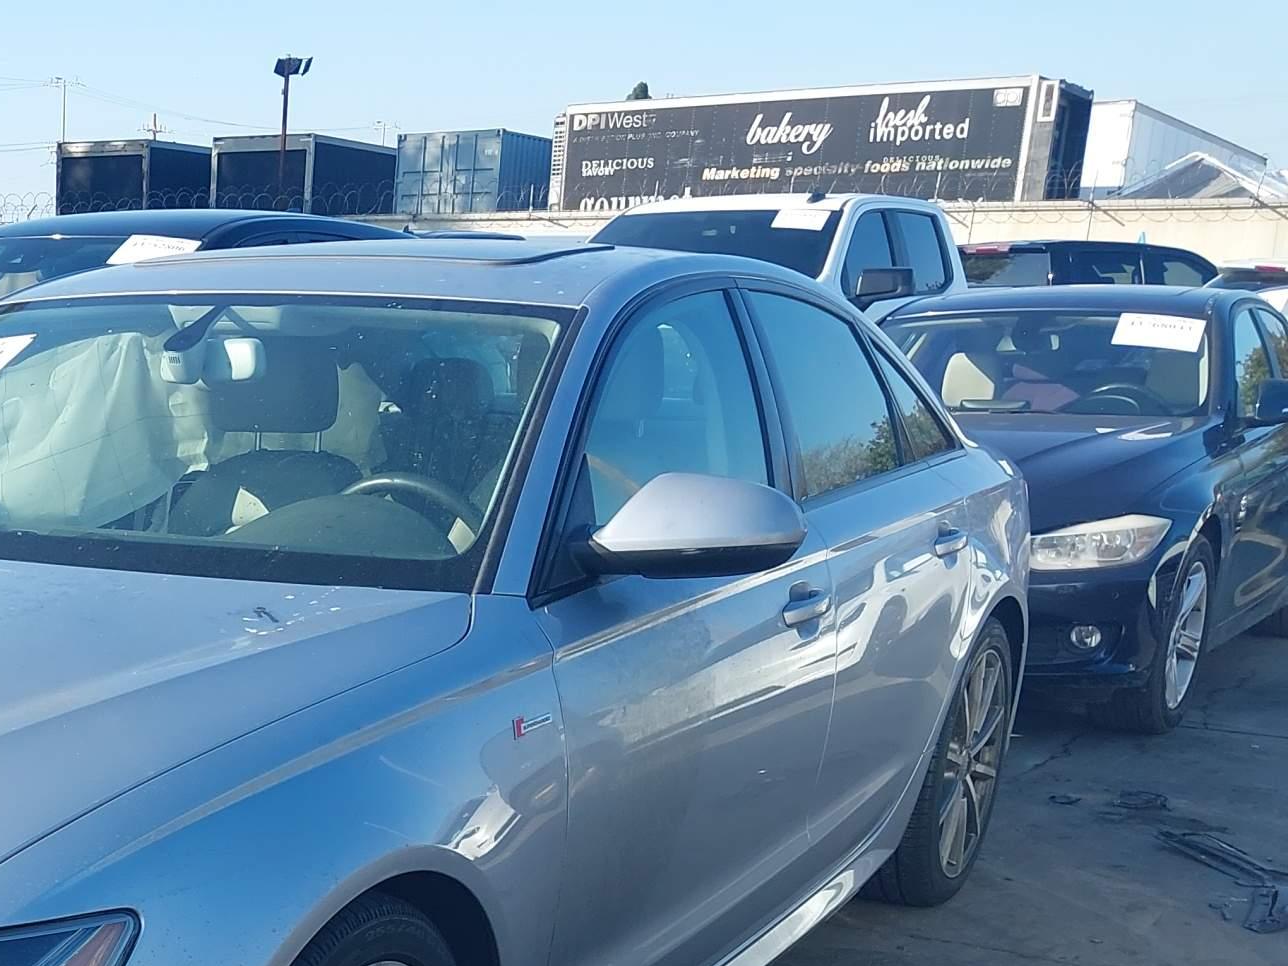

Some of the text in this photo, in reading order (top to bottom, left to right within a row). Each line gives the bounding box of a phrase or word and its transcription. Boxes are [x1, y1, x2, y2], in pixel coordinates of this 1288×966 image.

[746, 112, 833, 155] bakery
[869, 117, 970, 146] imported
[582, 157, 655, 170] DELICIOUS
[702, 165, 781, 181] Marketing
[863, 159, 910, 174] foods
[915, 156, 1012, 172] nationwide
